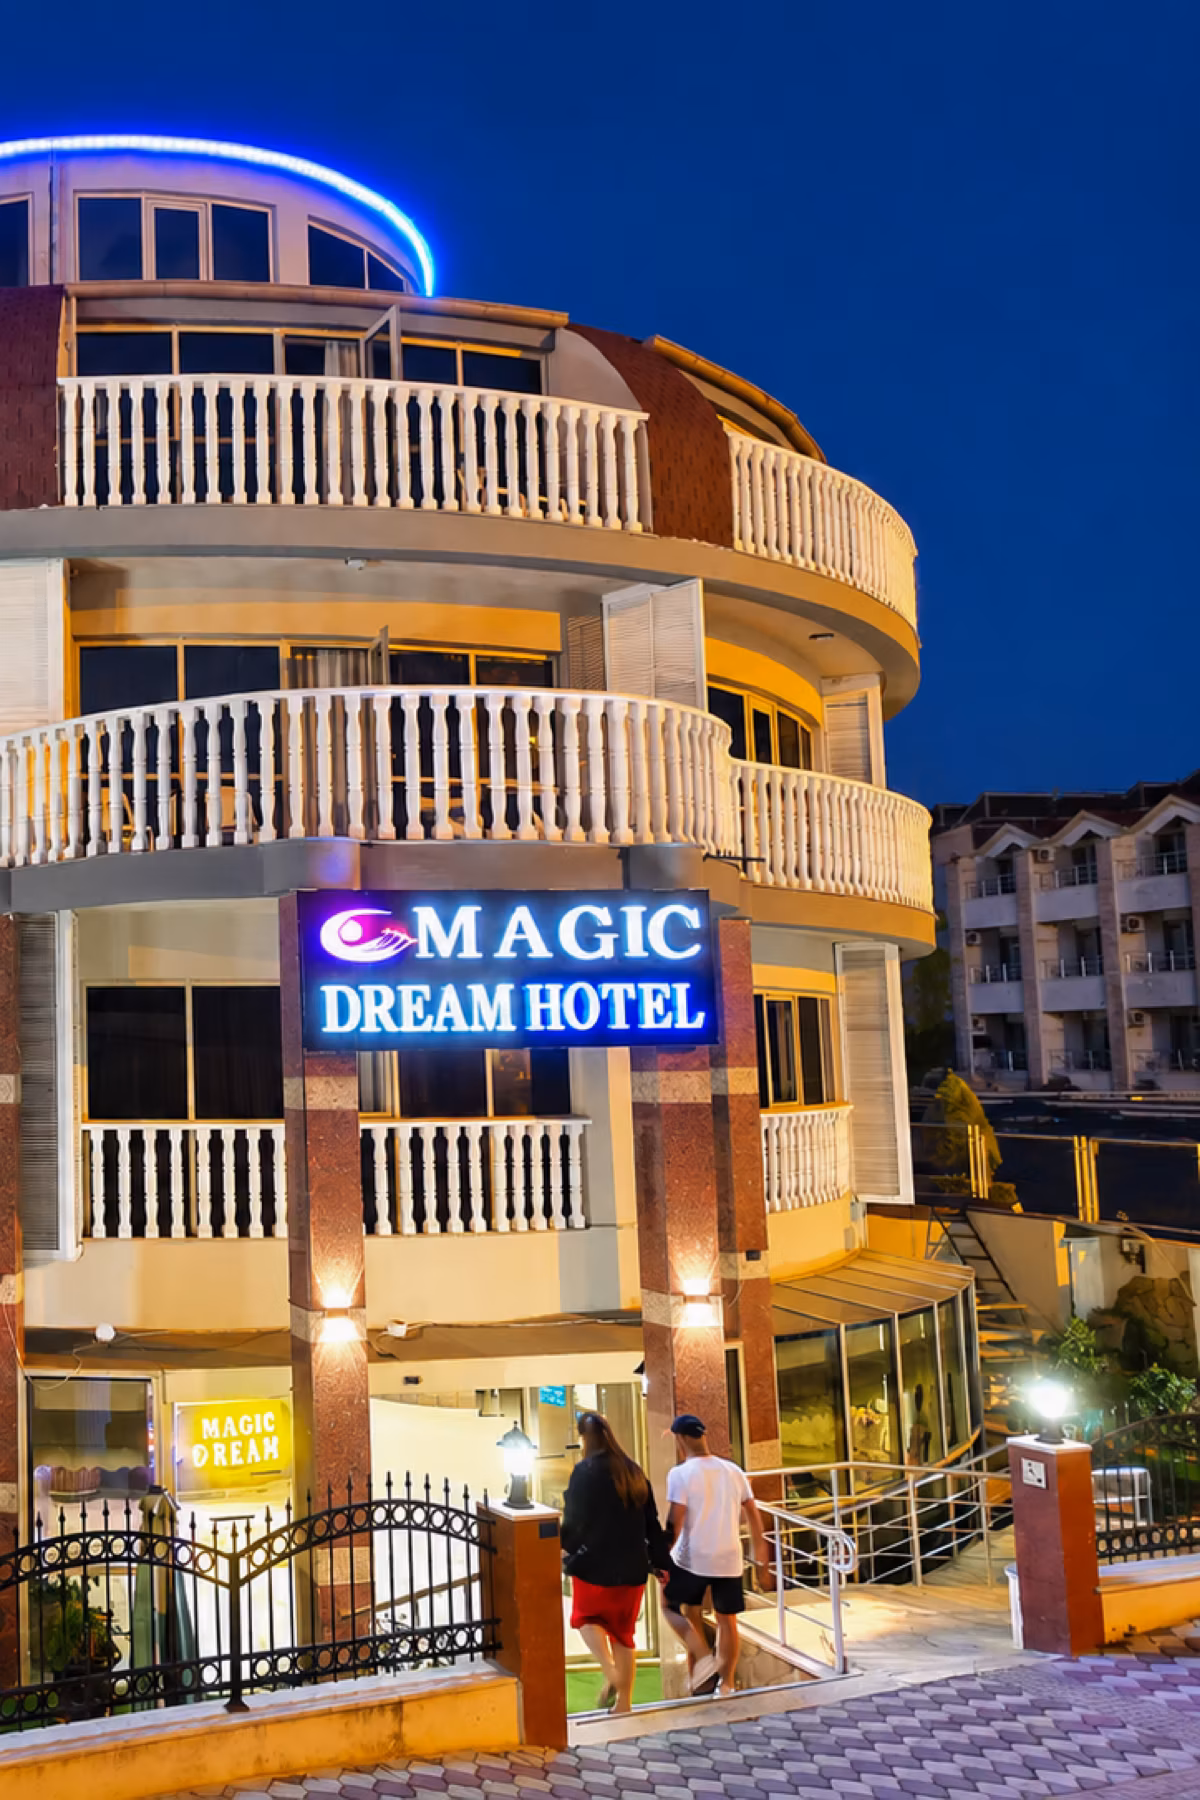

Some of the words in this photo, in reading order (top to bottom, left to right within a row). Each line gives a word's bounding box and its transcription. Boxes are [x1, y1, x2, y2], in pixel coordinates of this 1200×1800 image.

[412, 904, 701, 960] MAGIC
[320, 984, 517, 1033] DREAM
[525, 982, 706, 1031] HOTEL
[202, 1411, 275, 1440] MAGIC
